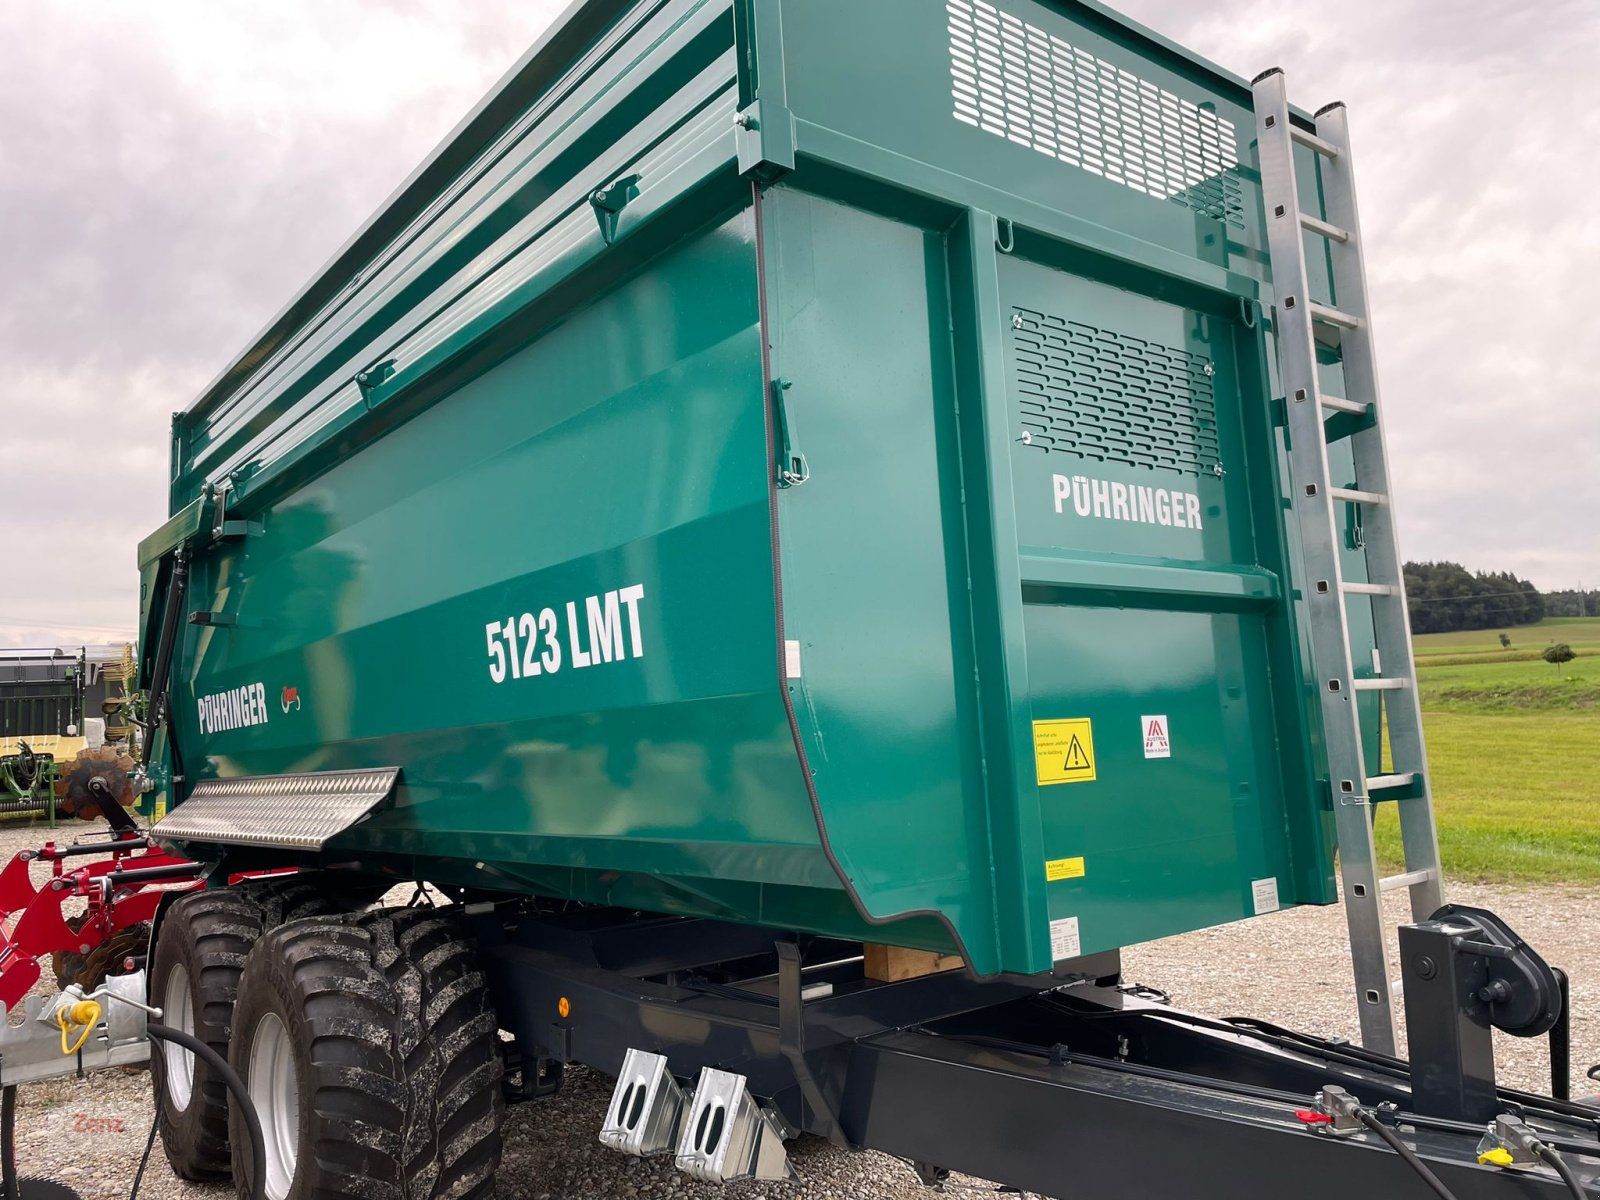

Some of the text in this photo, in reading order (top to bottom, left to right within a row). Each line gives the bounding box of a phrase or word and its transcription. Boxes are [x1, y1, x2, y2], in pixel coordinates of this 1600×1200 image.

[1052, 474, 1203, 530] PÜHRINGER
[485, 583, 645, 684] 5123 LMT
[197, 682, 269, 735] PÜHRINGER
